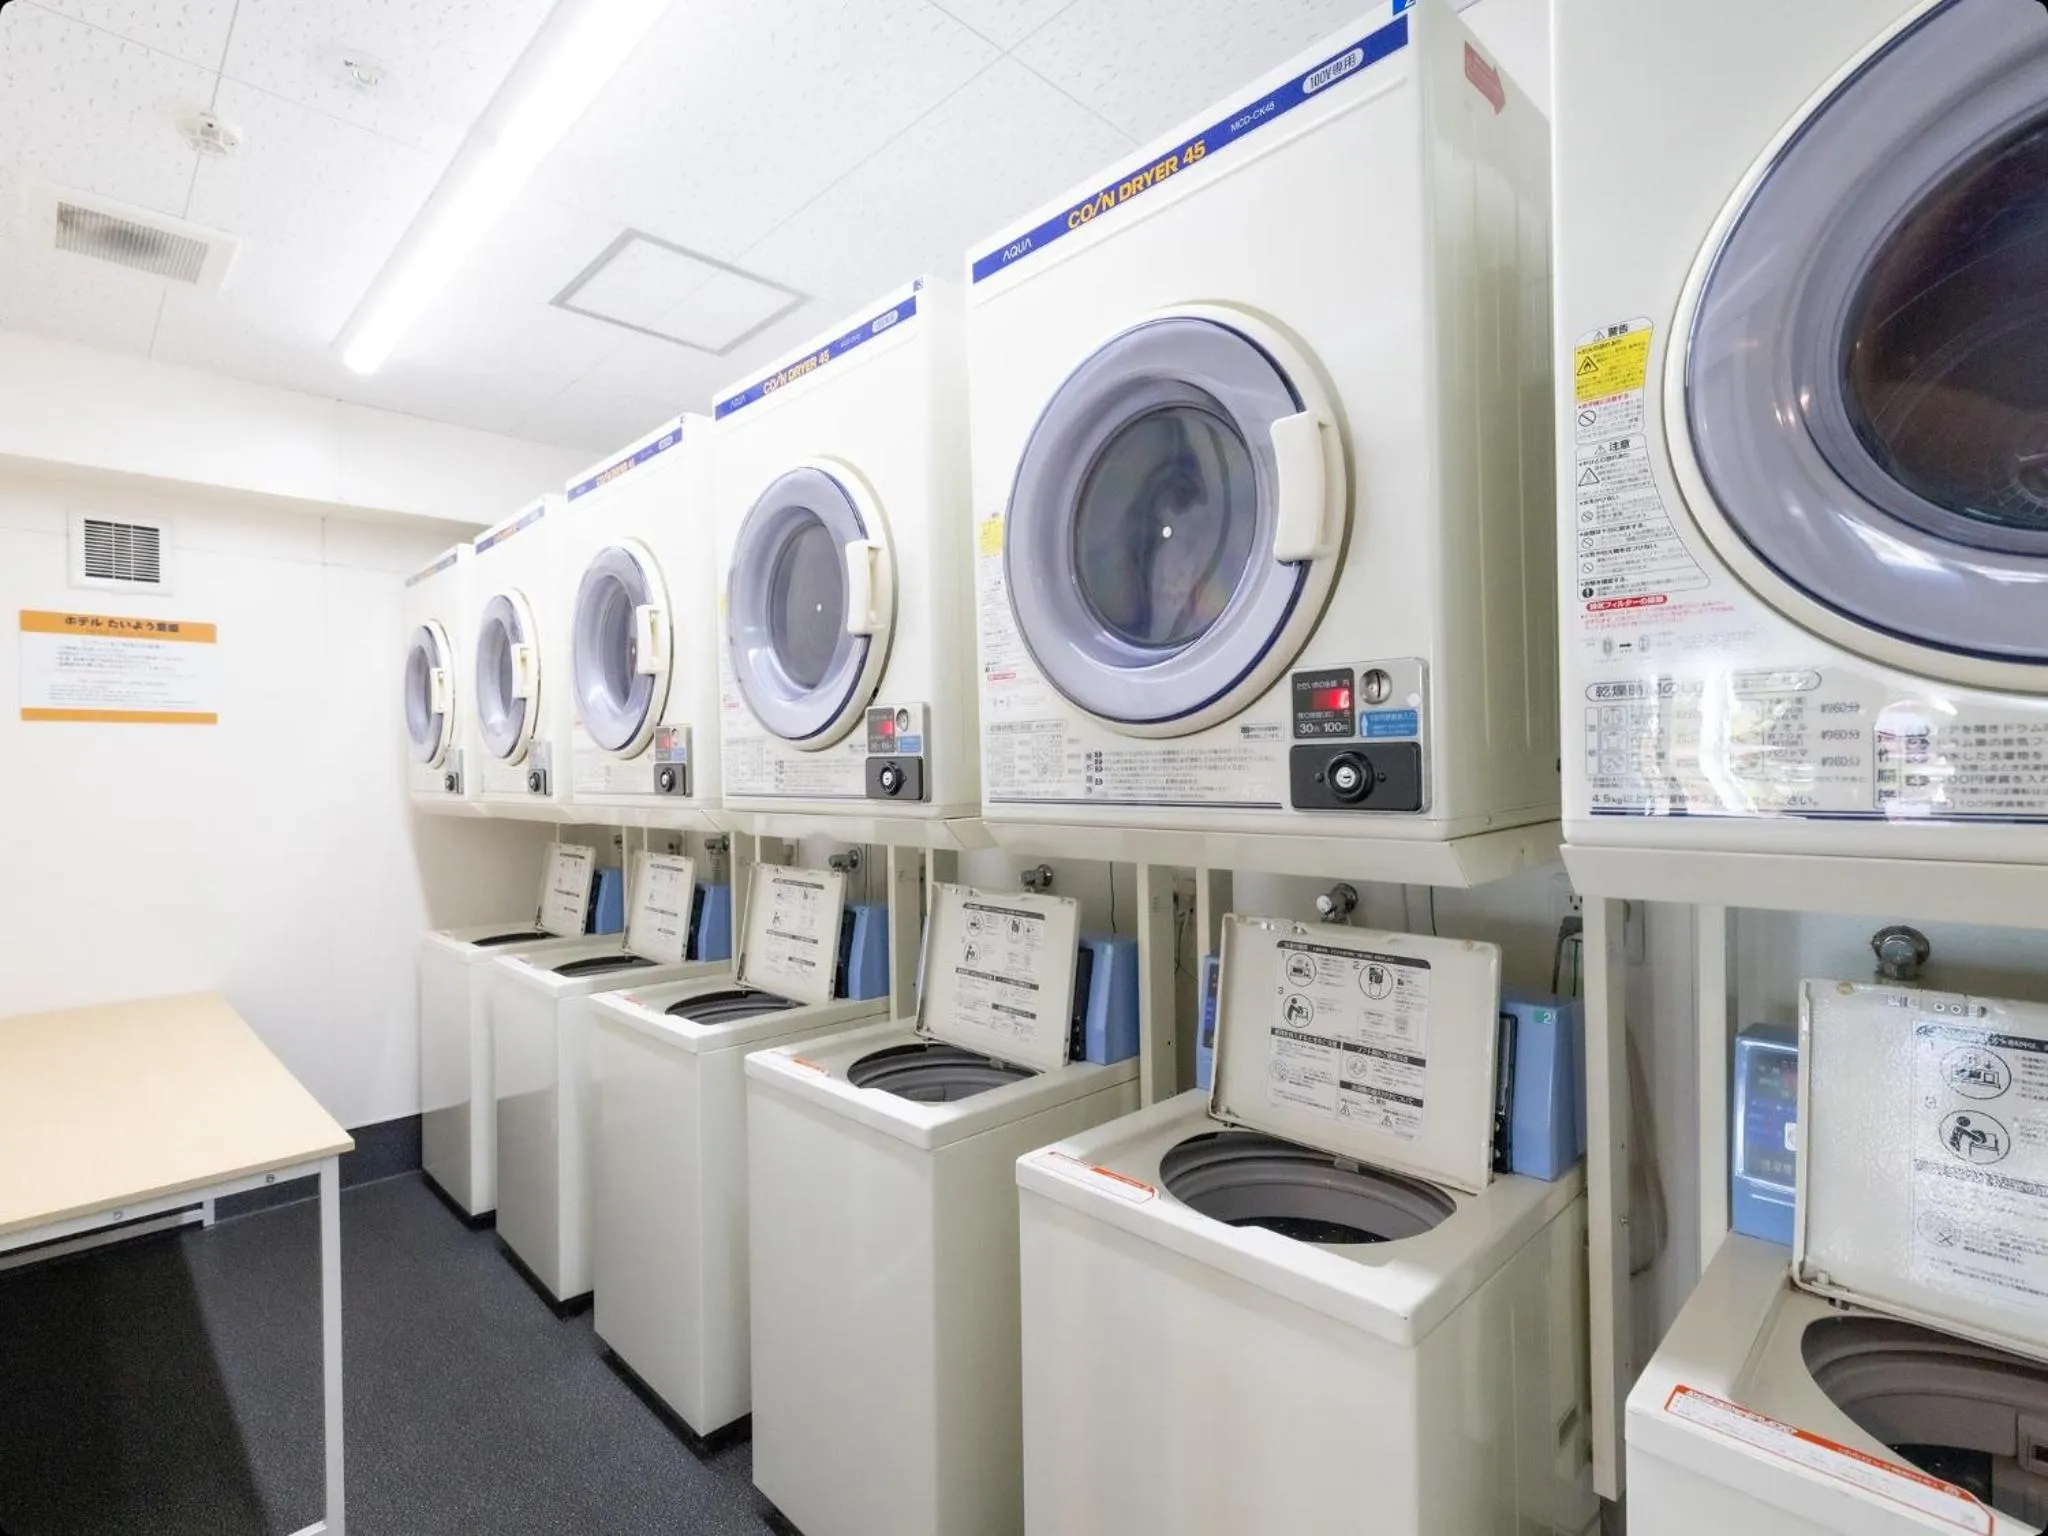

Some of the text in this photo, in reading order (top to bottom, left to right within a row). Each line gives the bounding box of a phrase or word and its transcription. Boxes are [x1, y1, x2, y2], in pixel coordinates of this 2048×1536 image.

[1310, 53, 1357, 89] 100V専用
[1119, 157, 1179, 202] DRYER
[1183, 140, 1207, 165] 45
[1002, 237, 1032, 262] AQUA
[65, 616, 103, 627] ホテル
